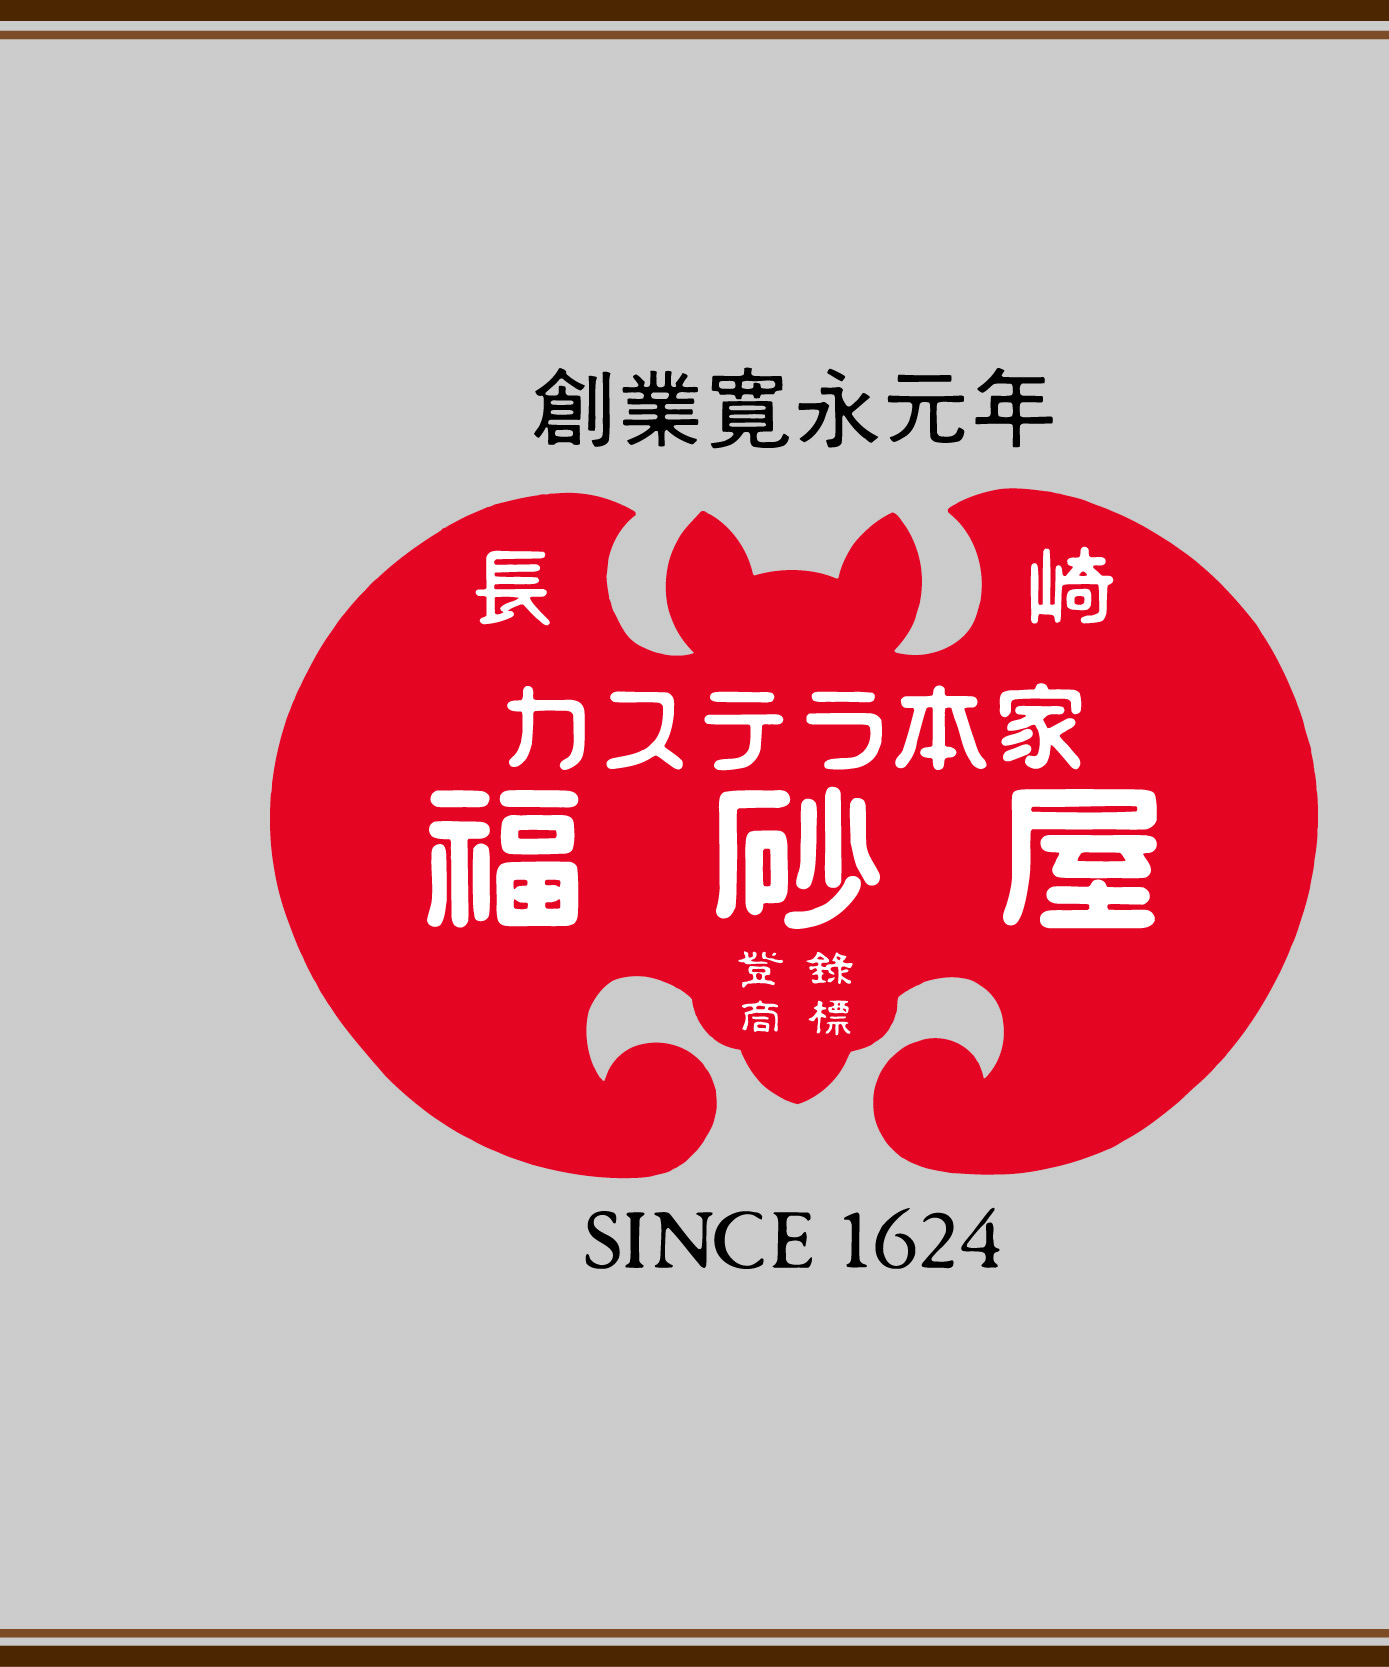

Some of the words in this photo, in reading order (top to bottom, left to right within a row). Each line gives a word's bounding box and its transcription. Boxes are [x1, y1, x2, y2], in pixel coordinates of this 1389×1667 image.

[507, 683, 1081, 770] カステラ本家
[427, 787, 1157, 929] 福砂屋
[586, 1210, 813, 1270] SINCE
[844, 1208, 1000, 1270] 1624
